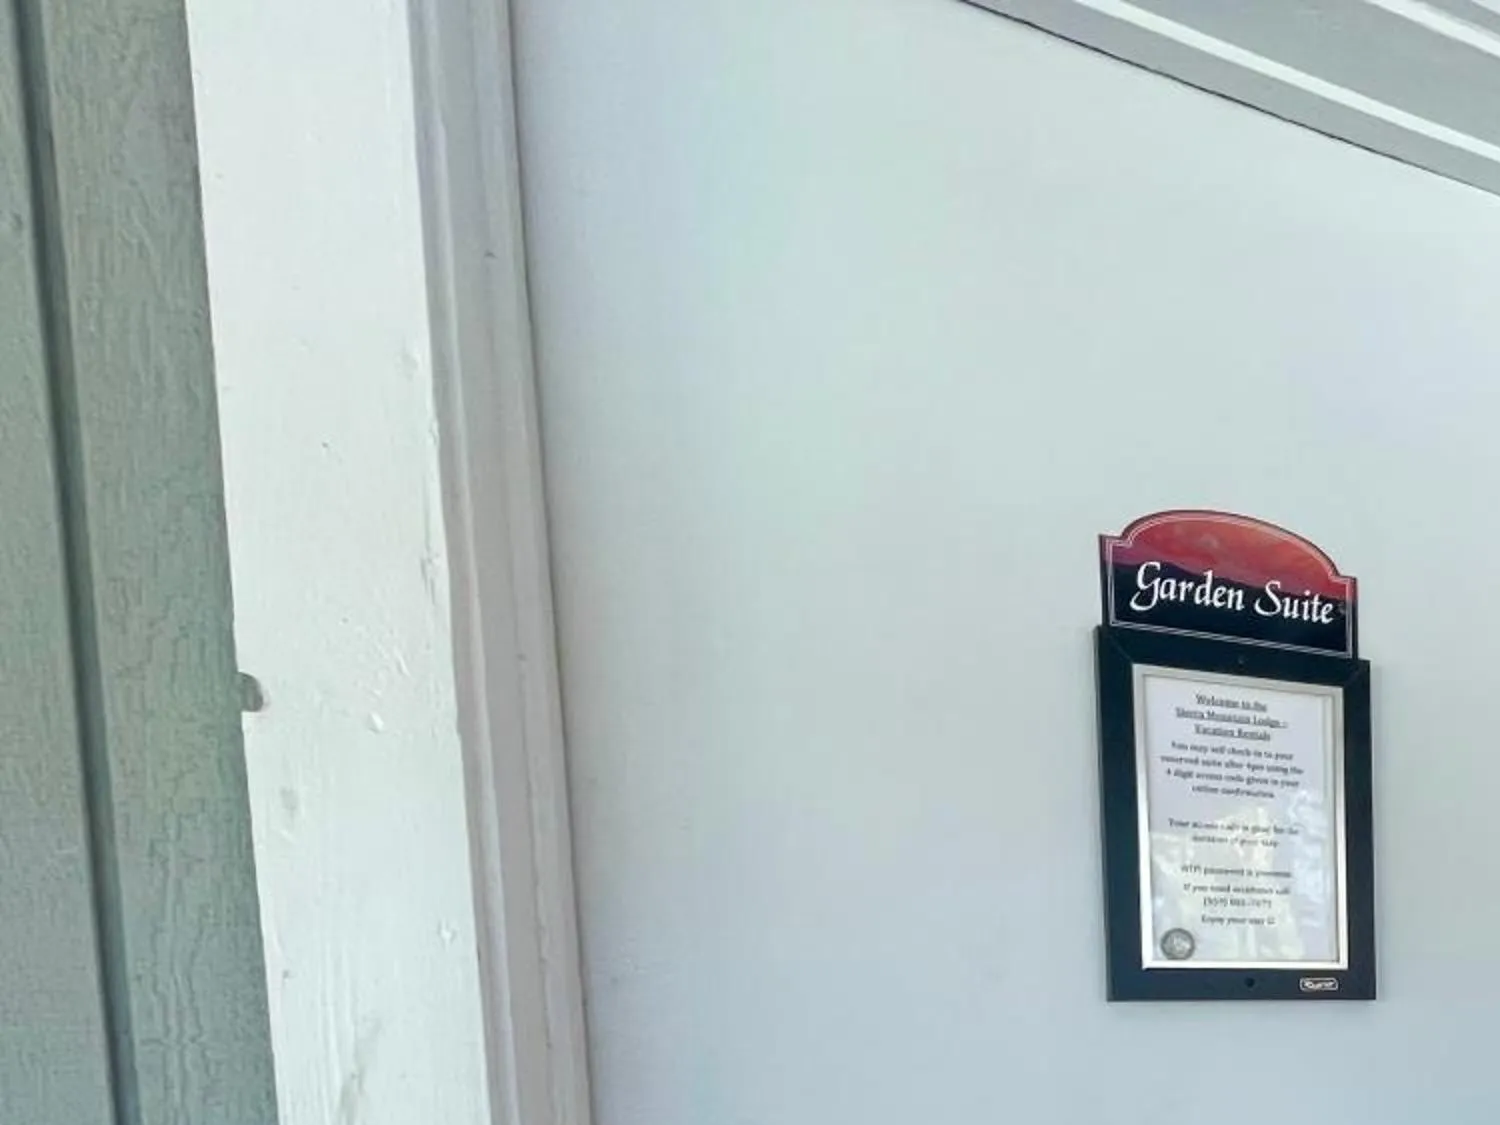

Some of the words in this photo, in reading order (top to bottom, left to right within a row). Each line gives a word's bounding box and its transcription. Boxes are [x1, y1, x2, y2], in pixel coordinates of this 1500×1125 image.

[1129, 561, 1245, 611] Garden
[1254, 580, 1334, 625] Suite
[1195, 693, 1239, 708] Welcome
[1241, 700, 1251, 709] to
[1253, 701, 1268, 712] the
[1207, 710, 1251, 724] Mountain
[1253, 715, 1281, 728] Lodge
[1194, 724, 1235, 738] Vacation
[1237, 728, 1271, 741] Rentals
